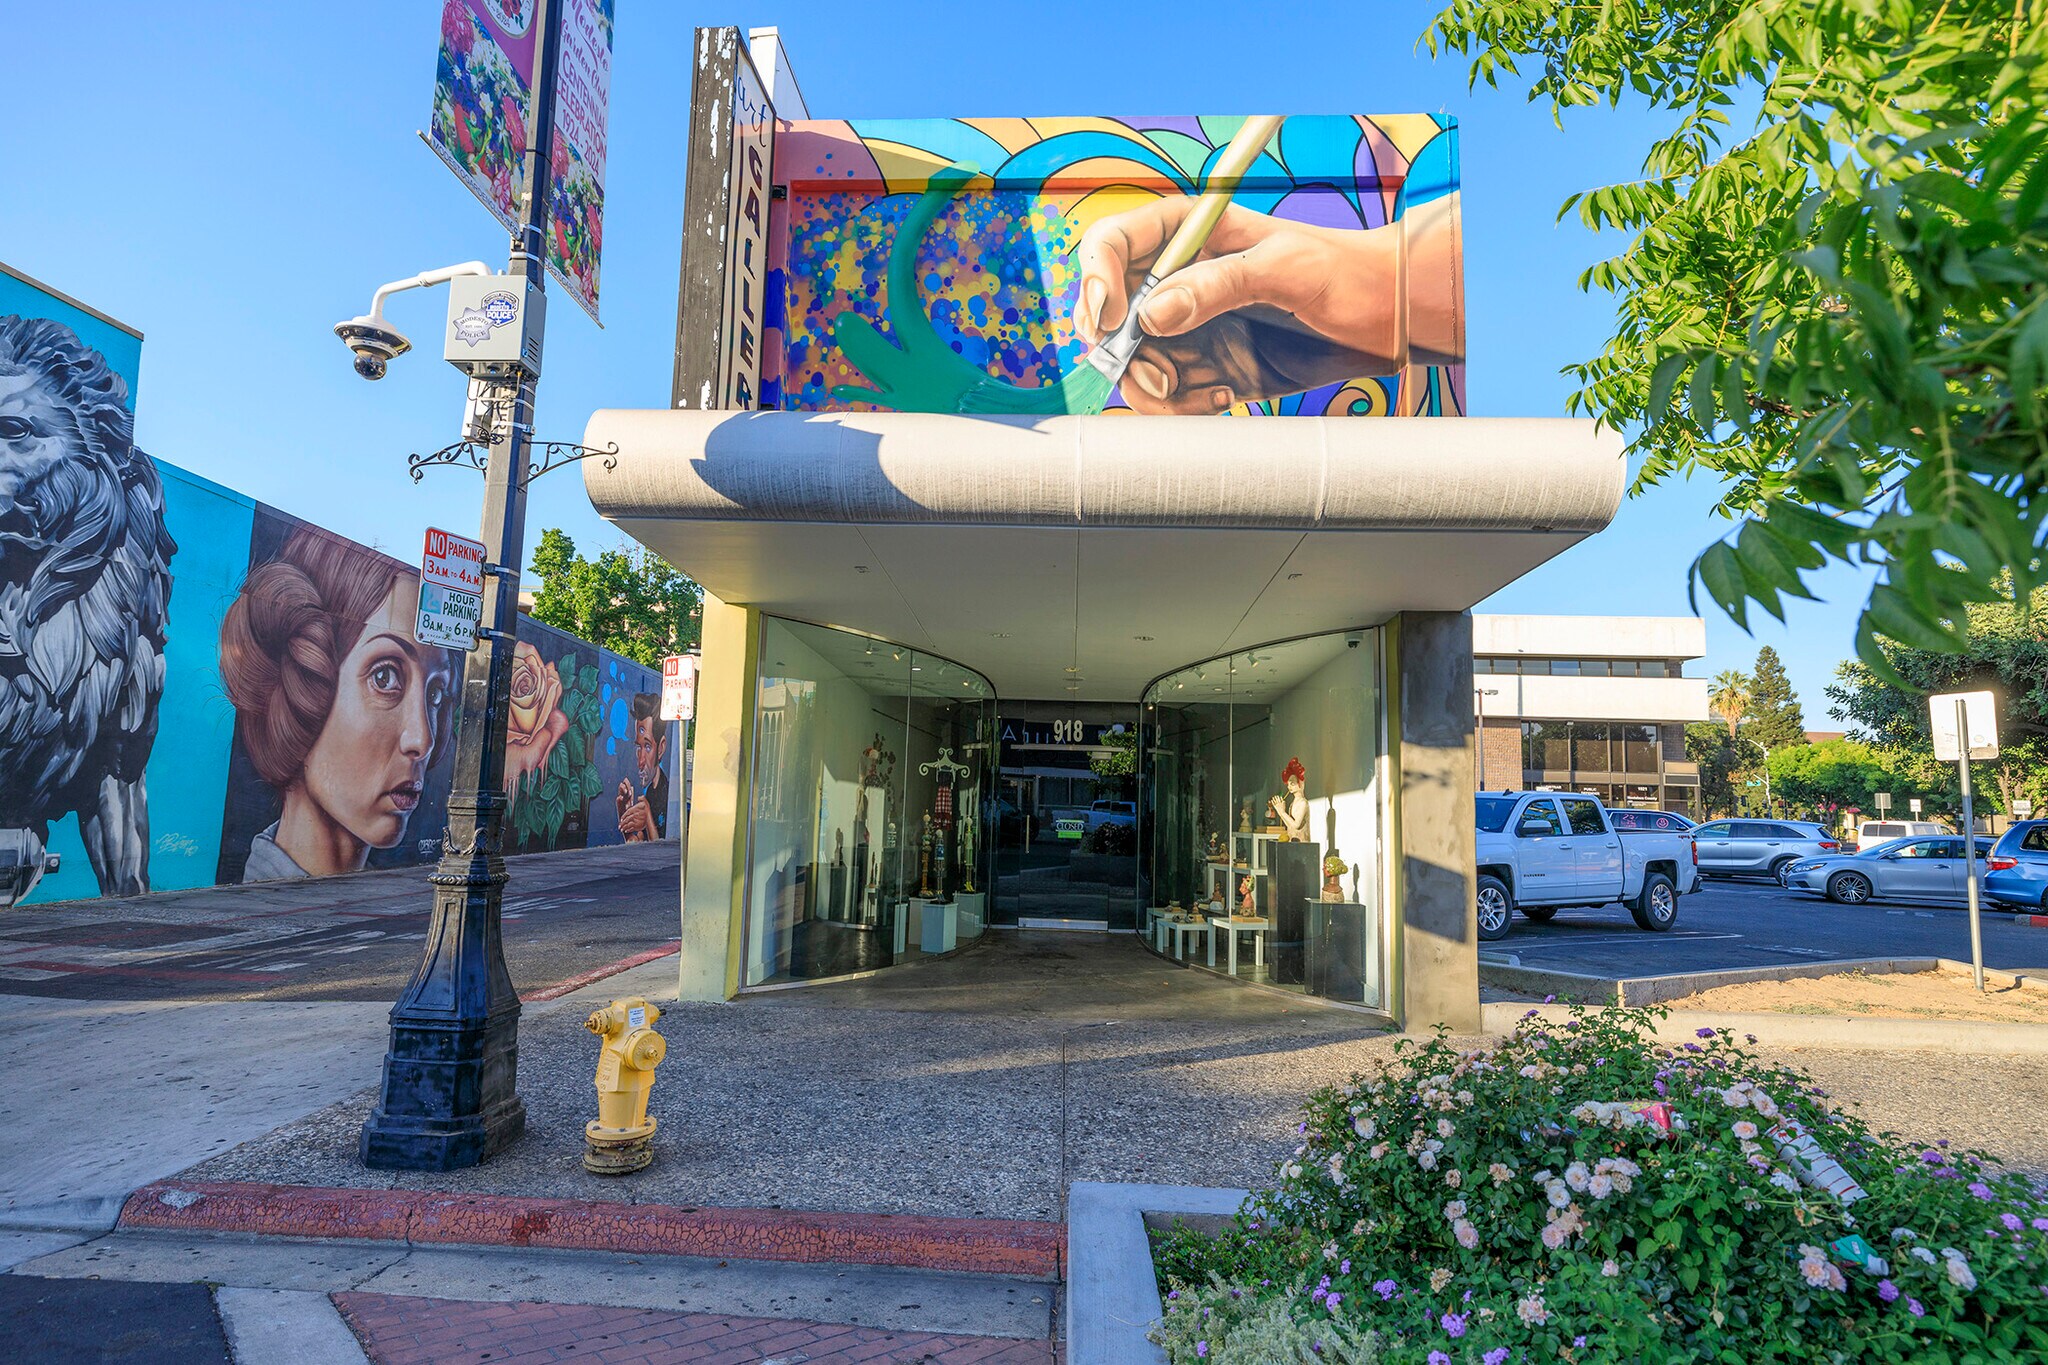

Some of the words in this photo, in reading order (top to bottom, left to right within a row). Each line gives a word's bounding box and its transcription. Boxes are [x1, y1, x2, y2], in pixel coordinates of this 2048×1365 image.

[562, 50, 607, 138] CENTENNIAL
[562, 108, 579, 147] 1924
[584, 140, 600, 177] 2024
[735, 144, 763, 410] GALLER
[460, 315, 489, 326] MODESTO
[487, 311, 511, 319] POLICE
[460, 330, 486, 338] POLICE
[430, 531, 445, 555] NO
[448, 541, 482, 563] PARKING
[449, 592, 475, 606] HOUR
[442, 602, 478, 622] PARKING
[666, 660, 677, 675] NO
[1053, 719, 1084, 742] 918
